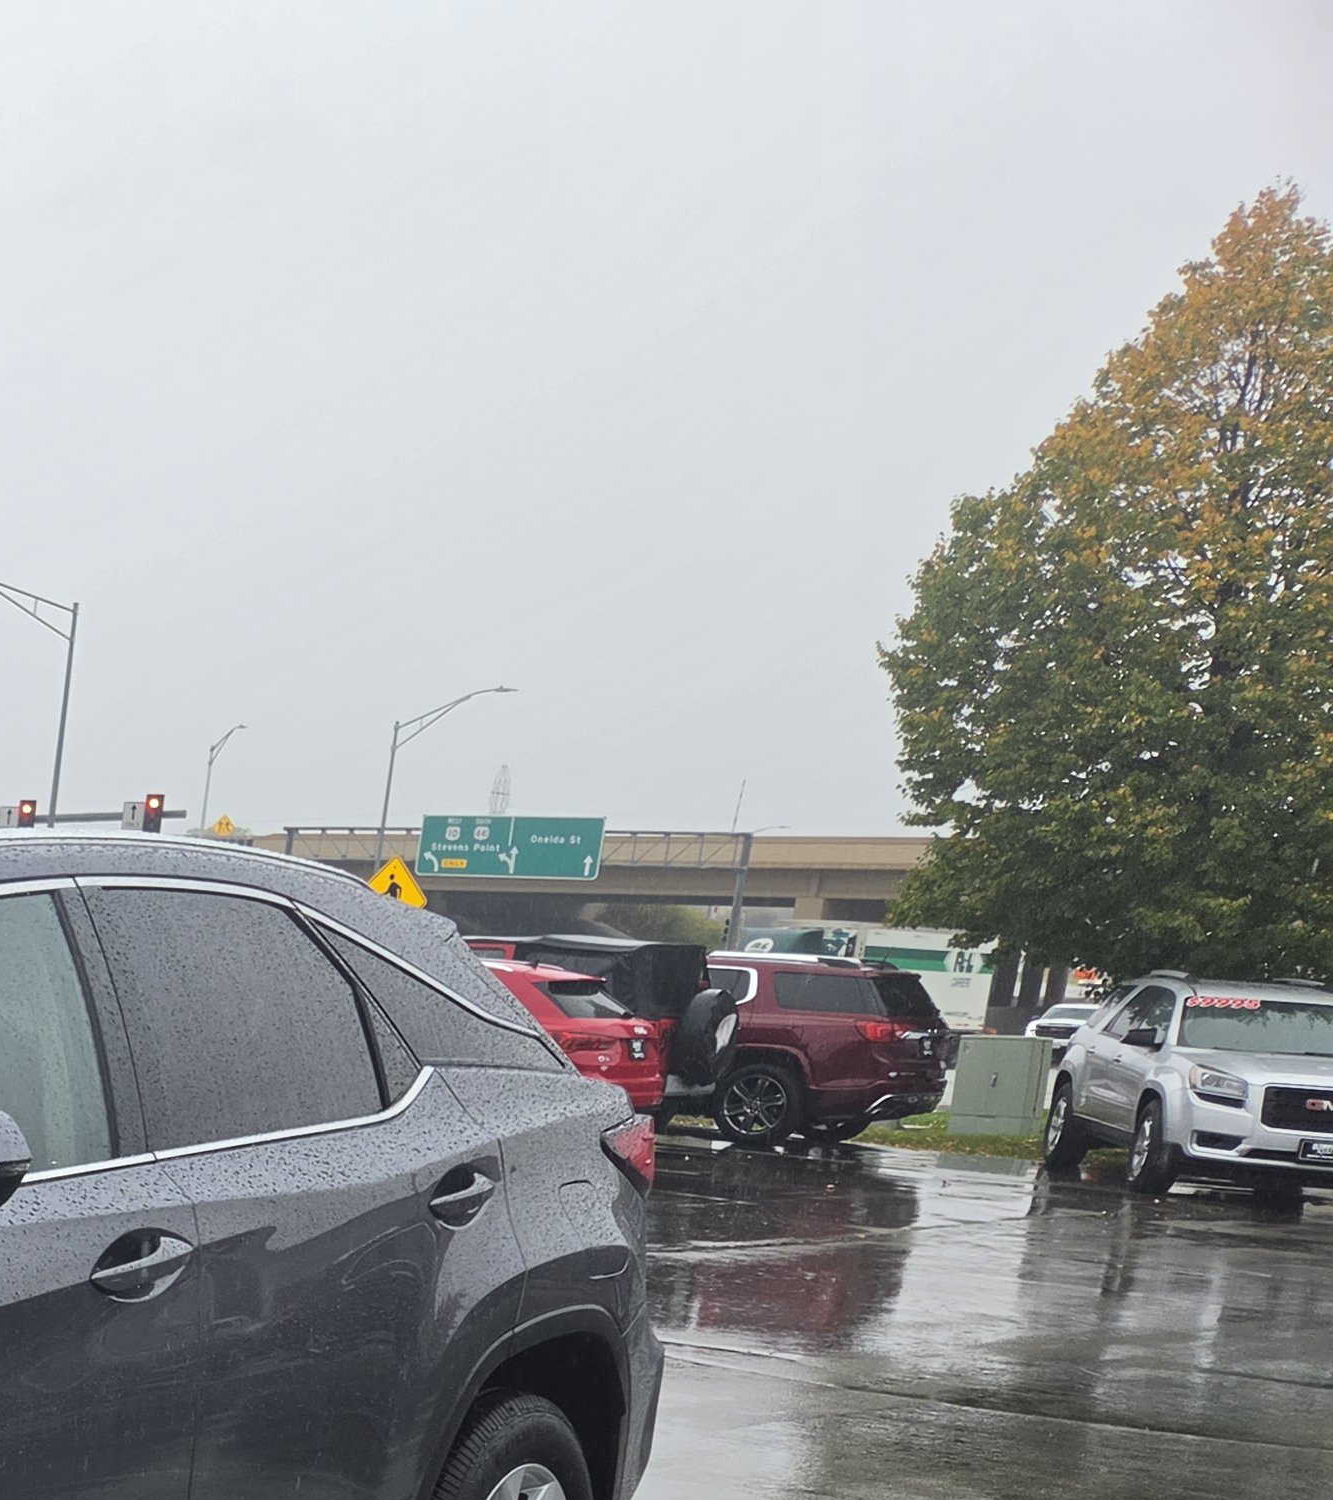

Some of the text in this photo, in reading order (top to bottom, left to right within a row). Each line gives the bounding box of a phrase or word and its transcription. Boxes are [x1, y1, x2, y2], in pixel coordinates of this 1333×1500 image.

[530, 835, 581, 844] Oneida St
[431, 843, 500, 852] Stevens Point
[1306, 1099, 1333, 1111] GM
